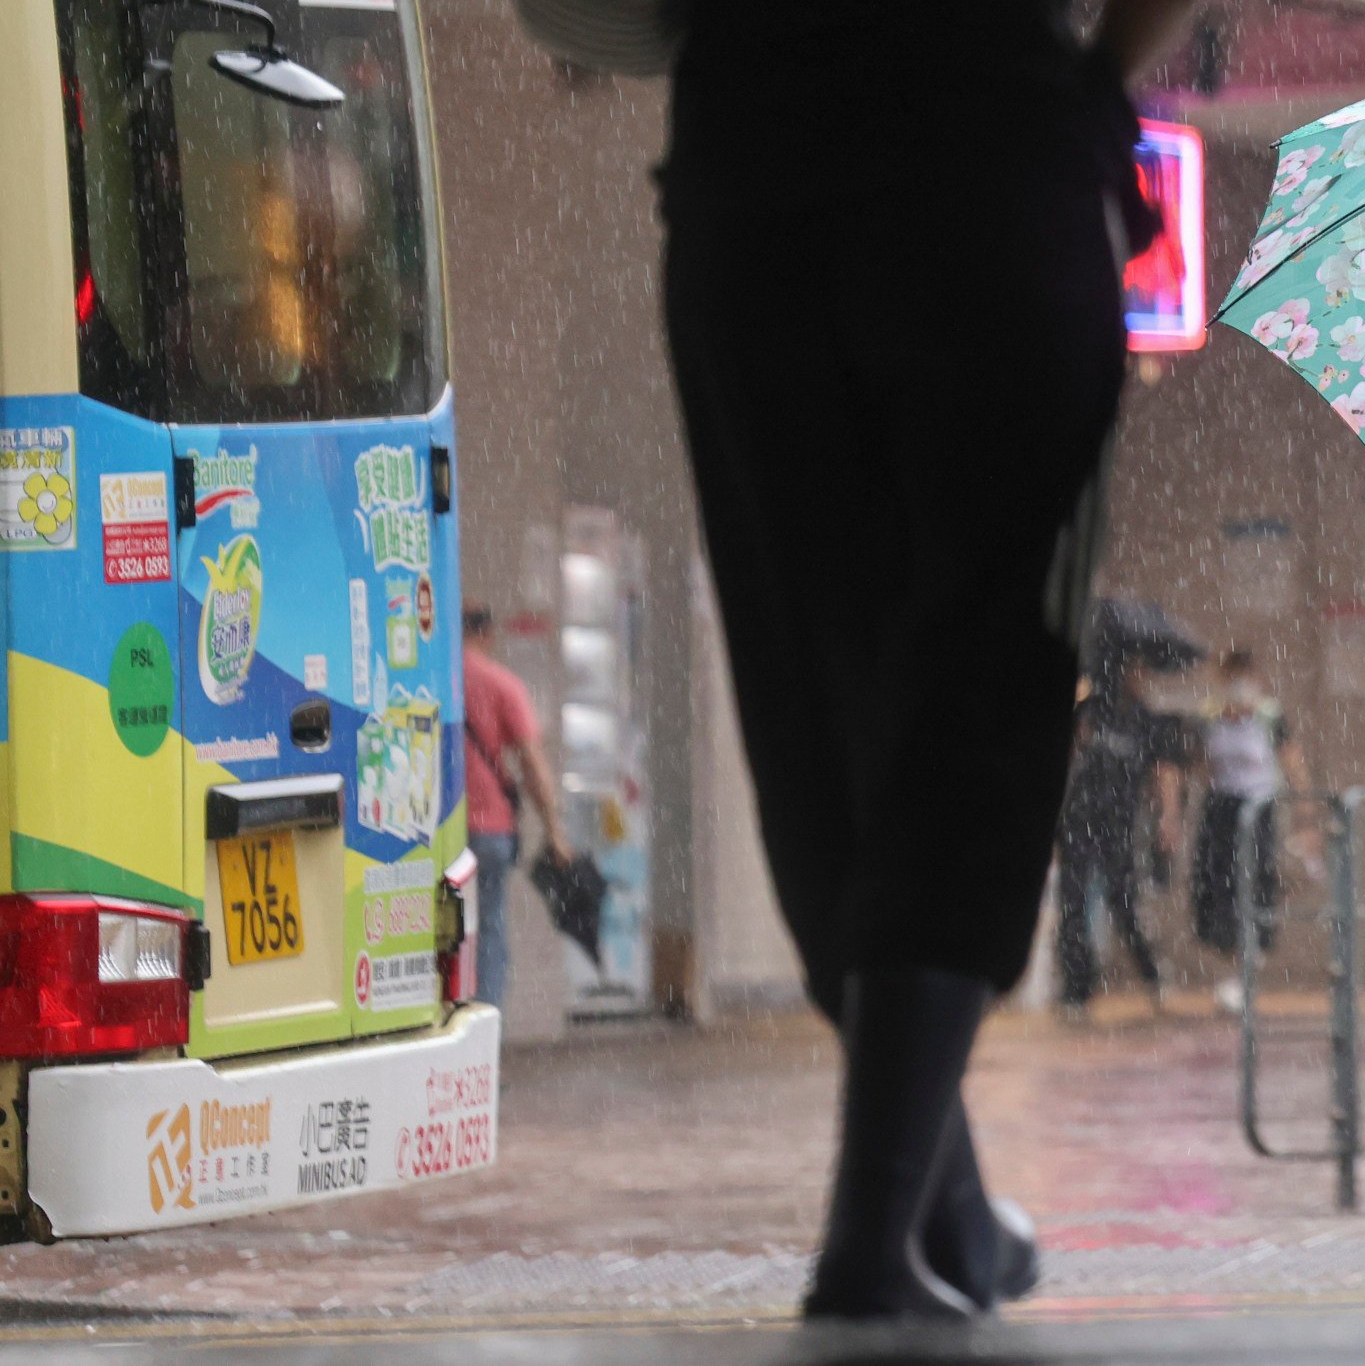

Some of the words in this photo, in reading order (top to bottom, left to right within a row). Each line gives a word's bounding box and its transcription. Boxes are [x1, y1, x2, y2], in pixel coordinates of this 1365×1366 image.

[118, 556, 144, 579] 3526
[145, 555, 169, 577] 0593
[130, 648, 154, 668] PSL
[212, 617, 250, 659] 安而康
[242, 840, 277, 896] VZ
[231, 893, 298, 956] 7056
[200, 1098, 271, 1155] QConcept
[300, 1096, 370, 1157] 小巴廣告
[412, 1121, 452, 1177] 3526
[455, 1113, 491, 1169] 0593
[297, 1158, 347, 1194] MINIBUS
[350, 1156, 366, 1185] AD
